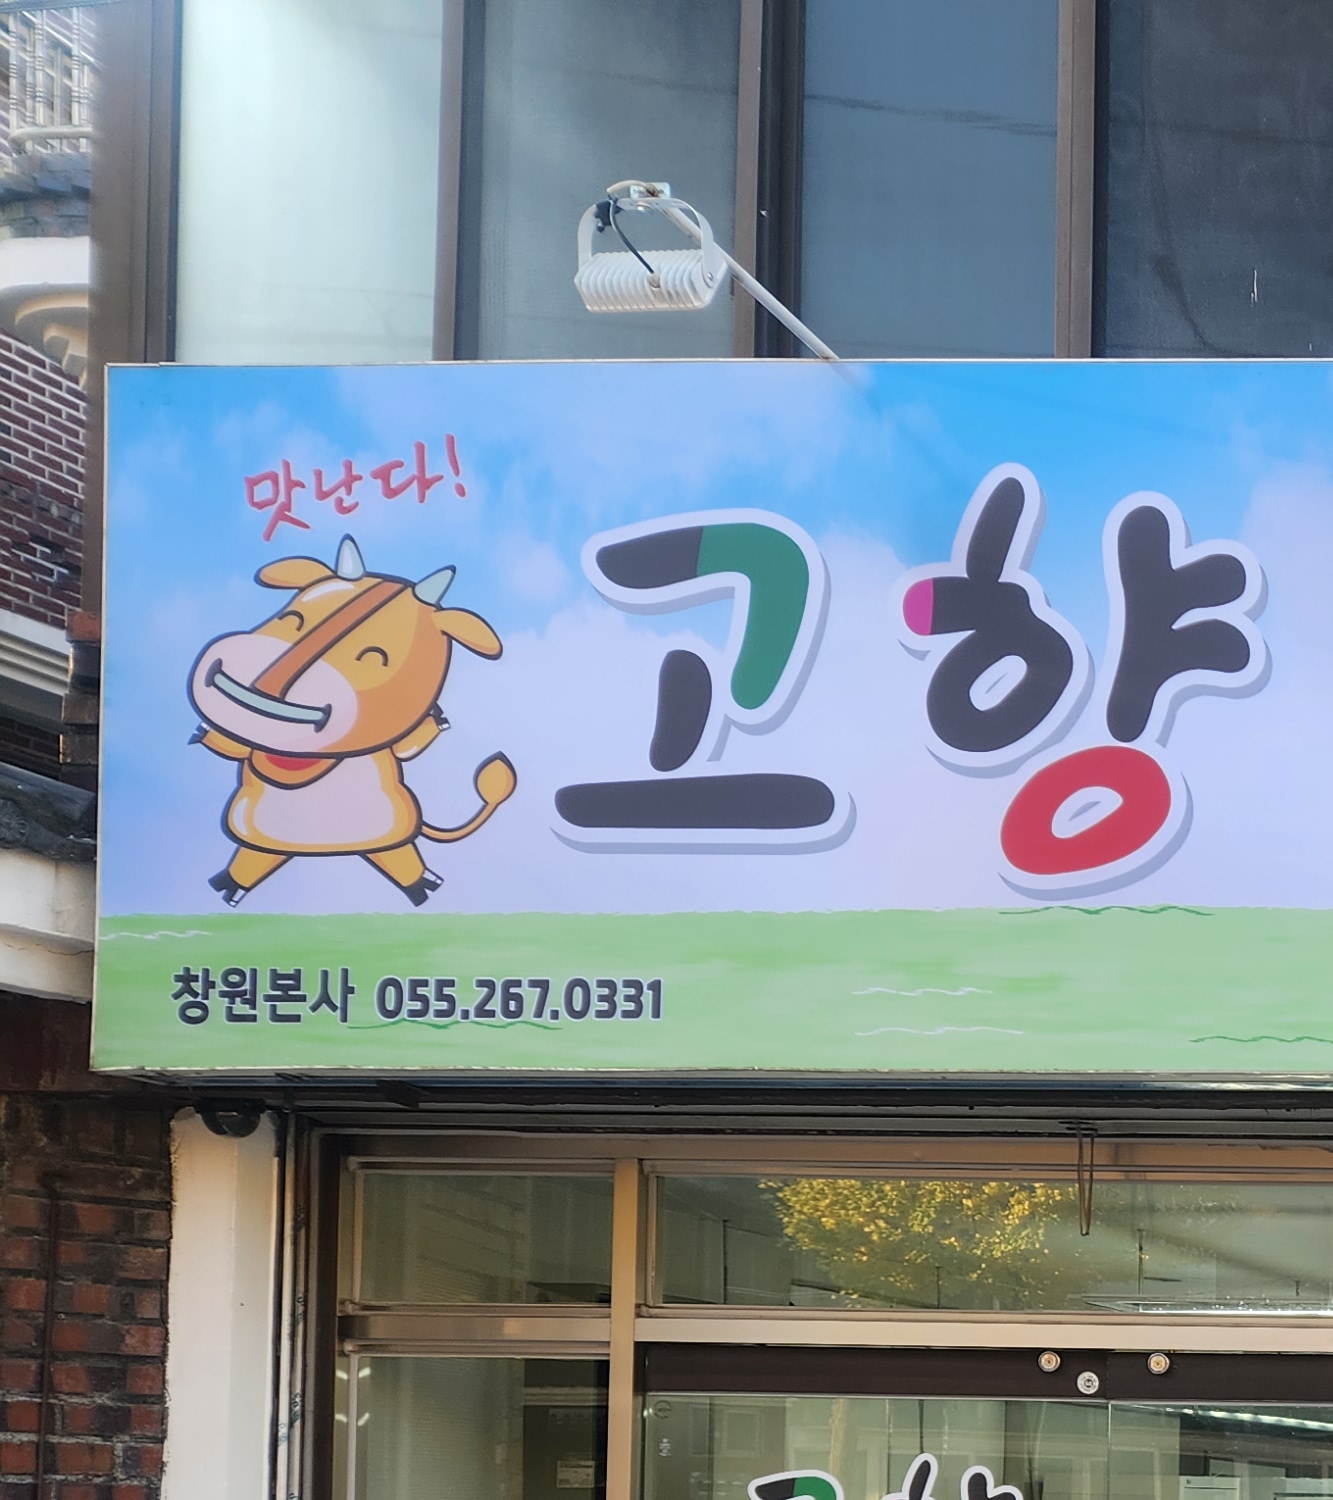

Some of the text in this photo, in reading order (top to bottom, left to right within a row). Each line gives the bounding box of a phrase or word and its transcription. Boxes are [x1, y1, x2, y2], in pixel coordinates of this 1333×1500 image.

[244, 433, 470, 543] 맛난다!
[555, 475, 1256, 878] 고향
[170, 964, 664, 1026] 창원본사 055.267.0331
